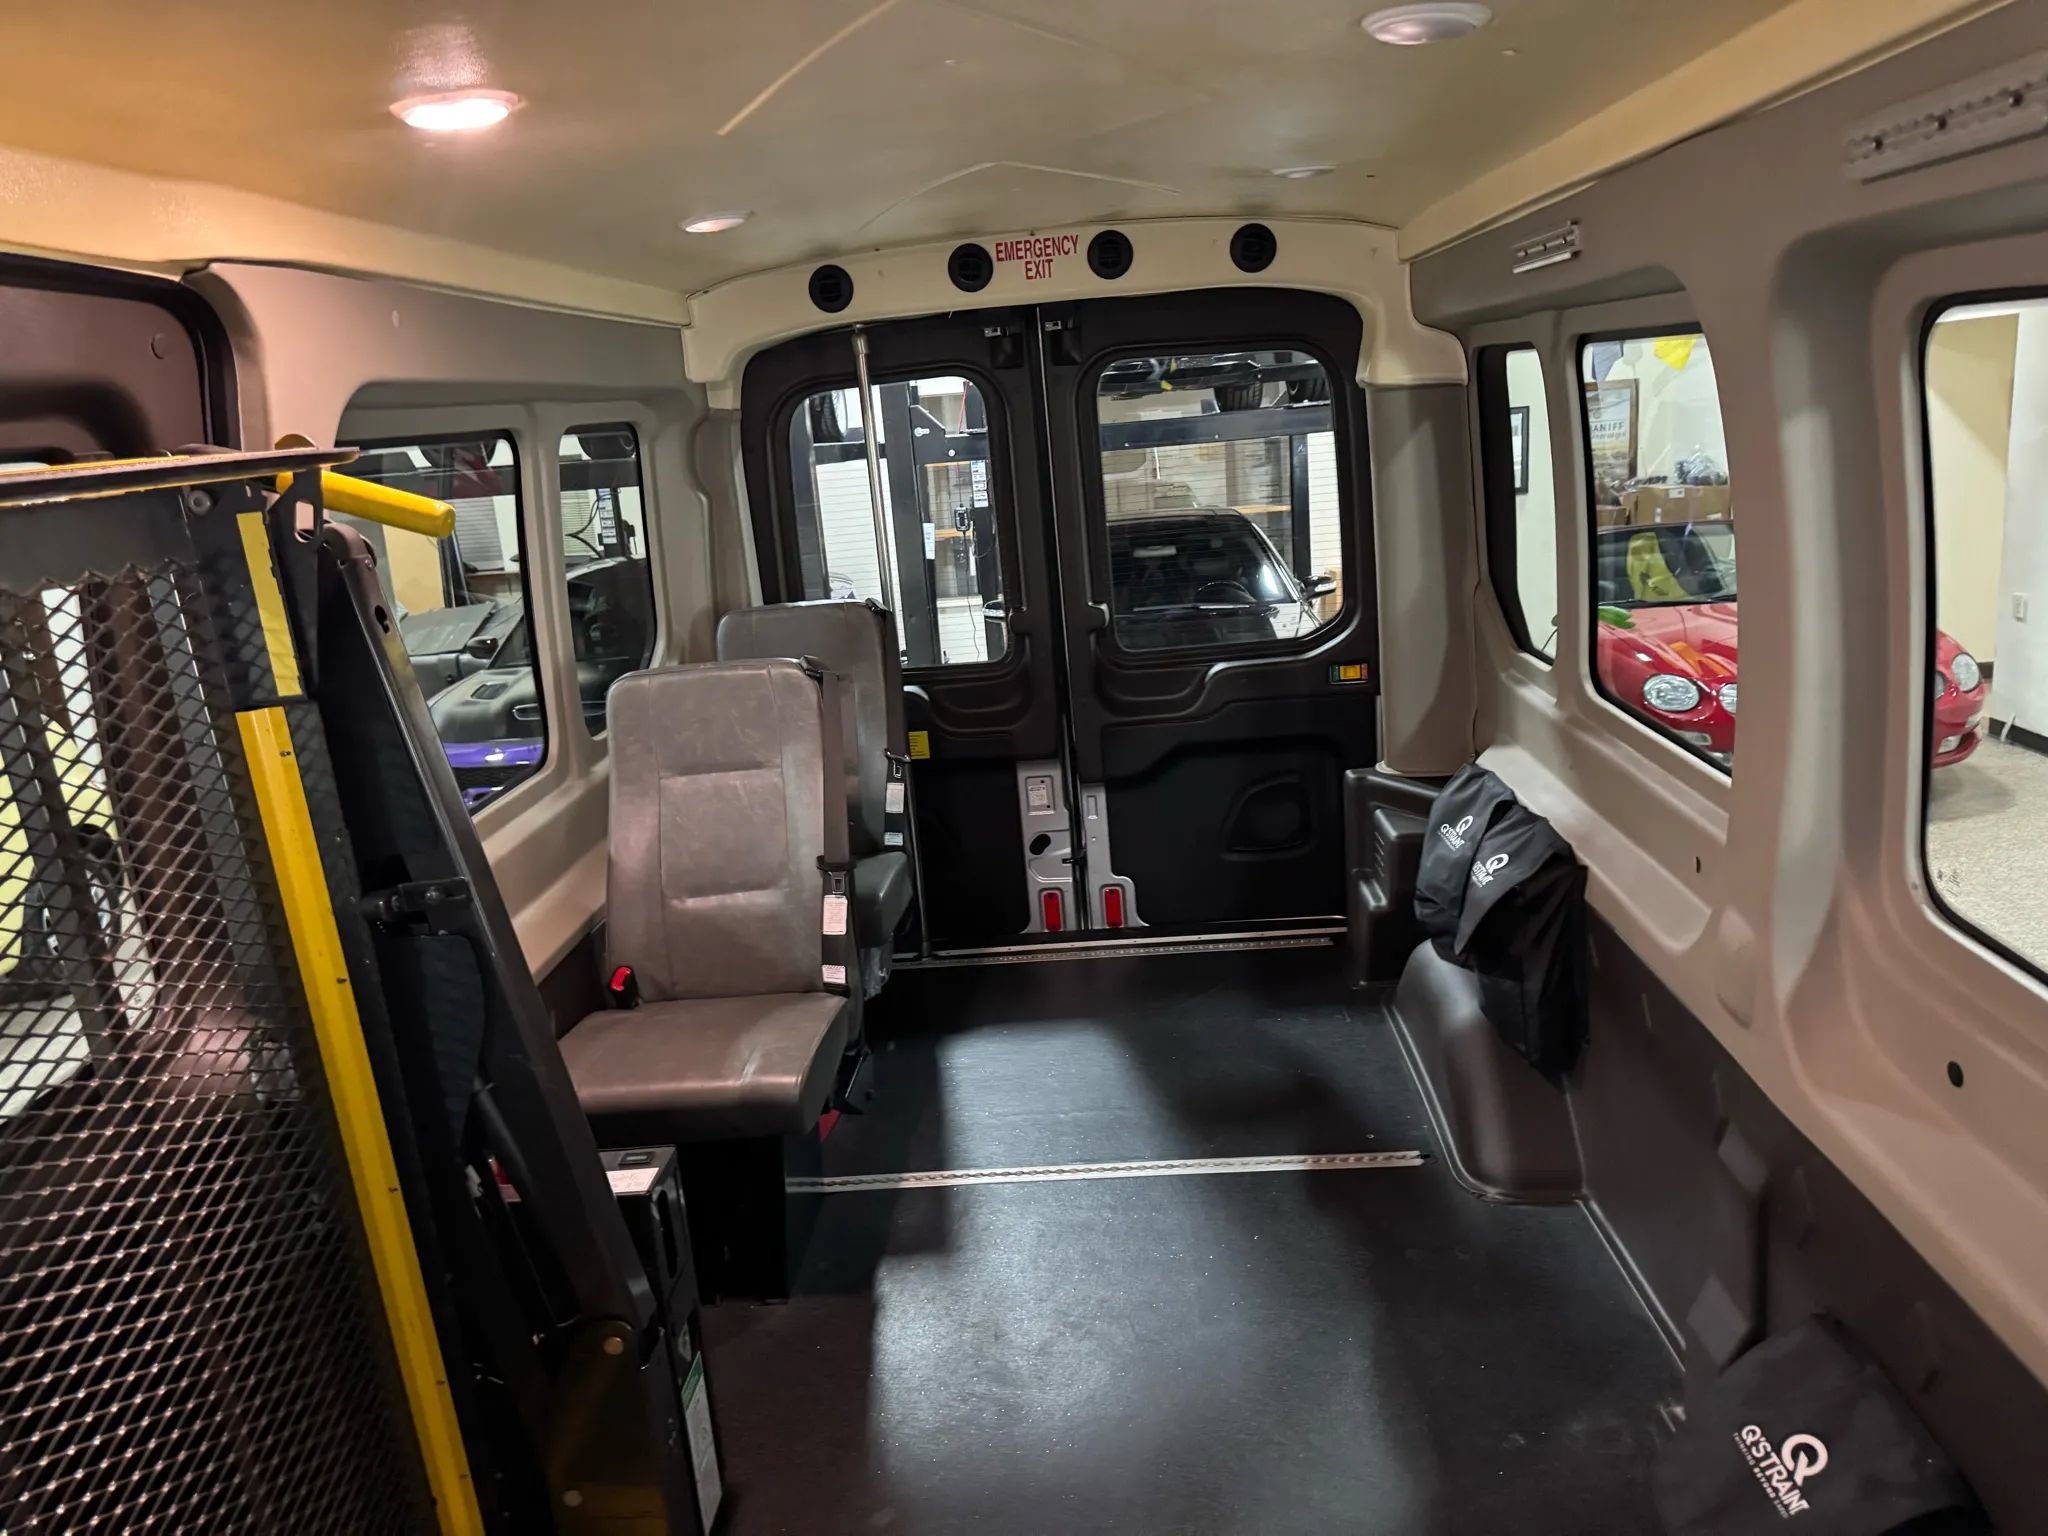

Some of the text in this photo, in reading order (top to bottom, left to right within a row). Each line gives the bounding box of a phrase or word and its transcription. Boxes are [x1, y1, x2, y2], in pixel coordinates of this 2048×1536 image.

[995, 234, 1079, 262] EMERGENCY
[1025, 259, 1053, 280] EXIT
[1590, 421, 1625, 432] ANIFF
[1486, 853, 1509, 874] Q
[1781, 1433, 1829, 1487] Q
[1753, 1467, 1776, 1498] BEYOND
